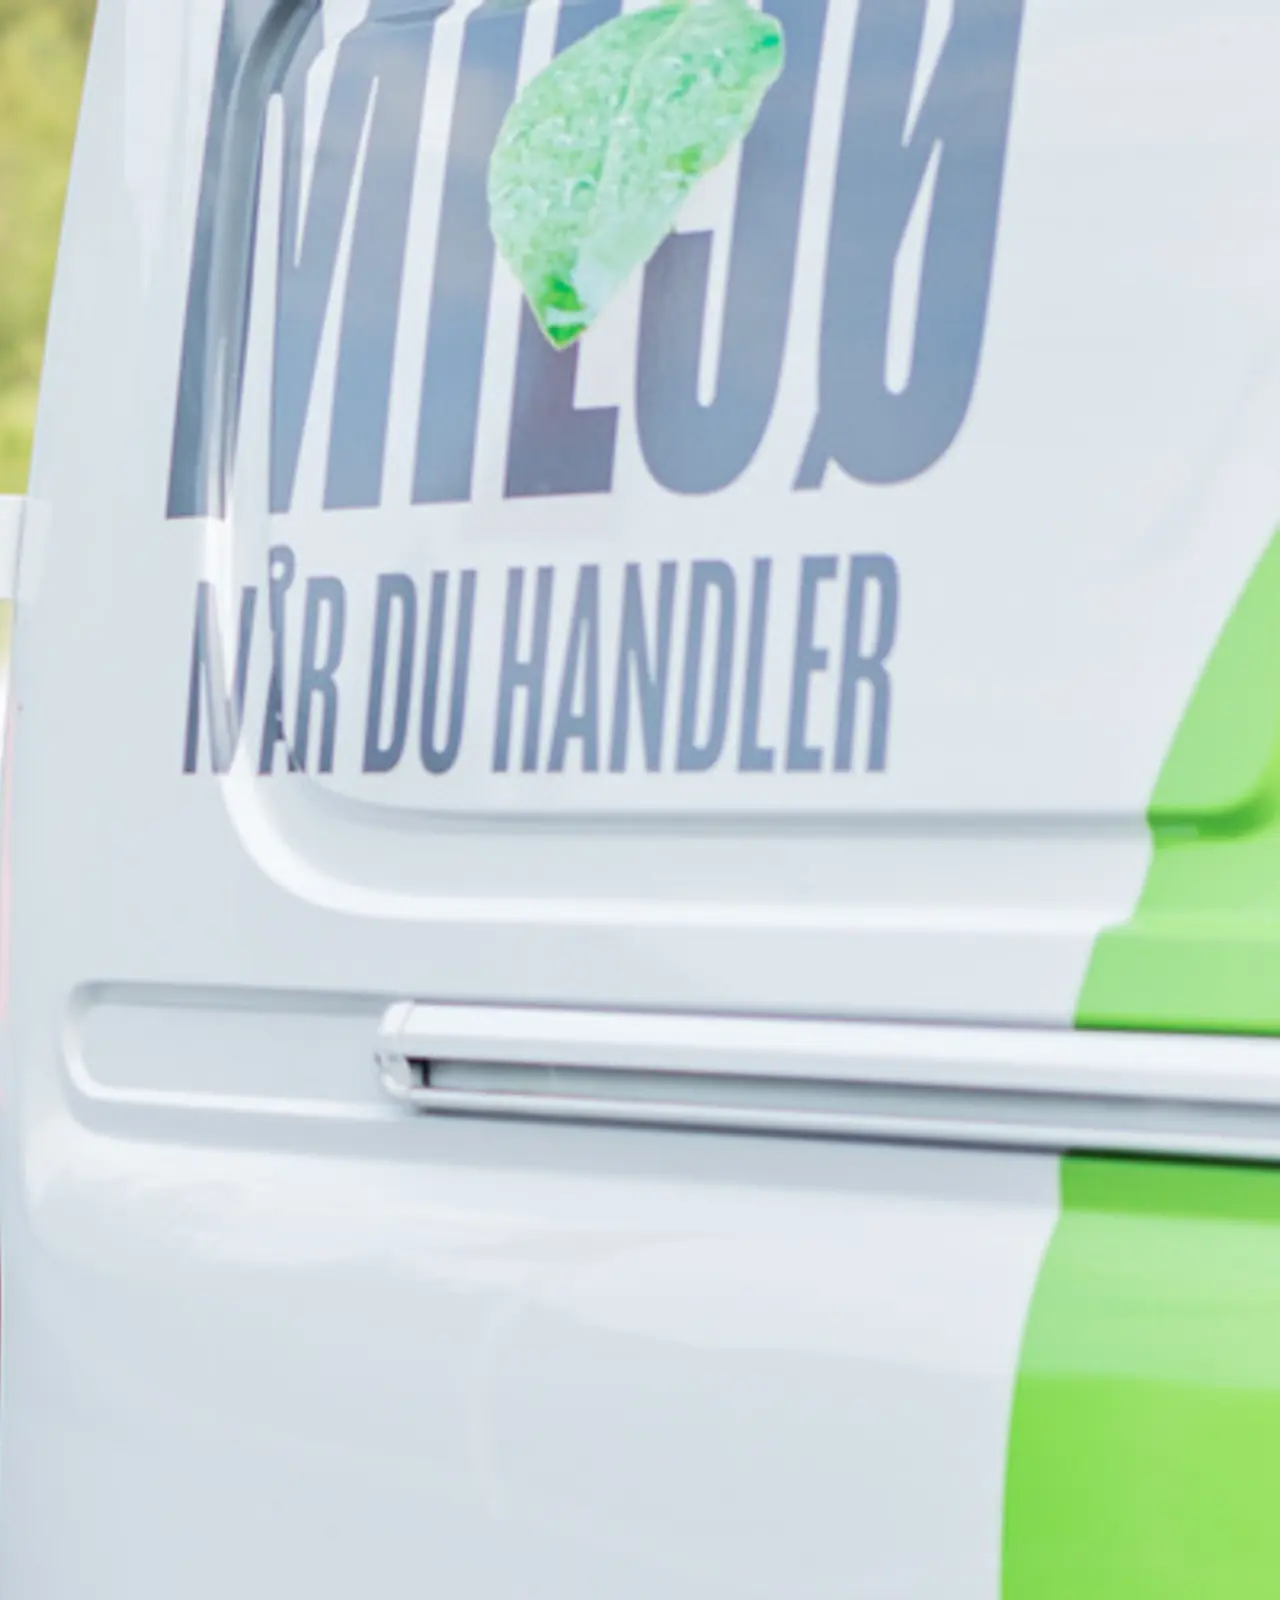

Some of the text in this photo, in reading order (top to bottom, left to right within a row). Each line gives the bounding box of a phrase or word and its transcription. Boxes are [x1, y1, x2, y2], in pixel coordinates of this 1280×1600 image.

[182, 544, 901, 775] NÅR DU HANDLER
